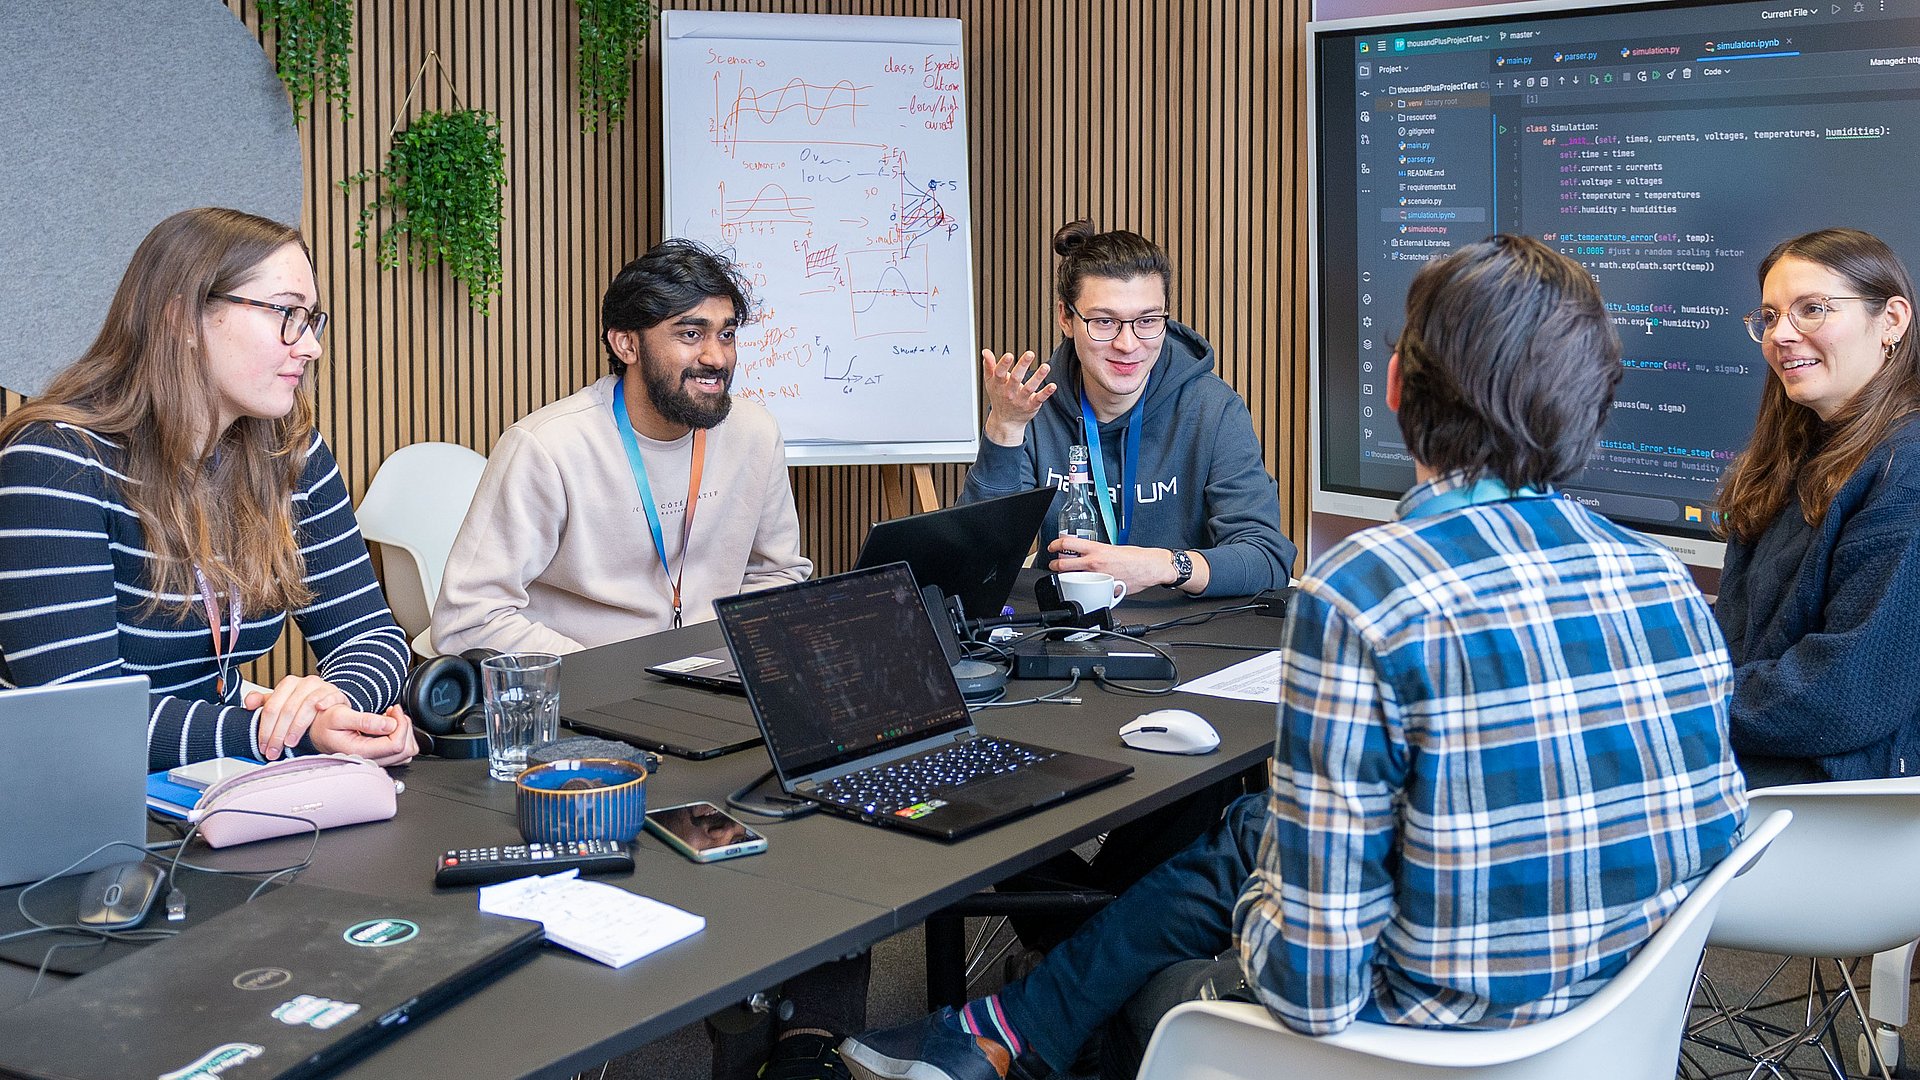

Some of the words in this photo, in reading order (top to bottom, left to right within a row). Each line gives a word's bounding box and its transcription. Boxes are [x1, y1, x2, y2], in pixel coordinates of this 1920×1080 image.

[1761, 11, 1792, 19] Current
[1793, 9, 1808, 17] File
[1509, 31, 1533, 39] master
[1407, 35, 1483, 48] thousandPlusProjectTest
[1716, 38, 1780, 50] simulation.ipynb
[1564, 52, 1597, 62] parser.py
[1632, 46, 1680, 57] simulation.py
[884, 56, 915, 74] class
[1506, 56, 1532, 66] main.py
[1870, 56, 1906, 67] Managed:
[1378, 63, 1402, 74] Project
[1704, 67, 1722, 76] Code
[1397, 82, 1478, 94] thousandPlusProjectTest
[1406, 113, 1437, 121] resources
[1406, 127, 1435, 138] .gitignore
[1526, 124, 1547, 133] class
[1550, 122, 1599, 132] Simulation:
[1543, 138, 1556, 146] def
[1625, 132, 1652, 143] times,
[1657, 131, 1699, 142] currents,
[1704, 129, 1748, 141] voltages,
[1753, 128, 1820, 139] temperatures,
[1825, 125, 1890, 138] humidities):
[1406, 142, 1430, 151] main.py
[1560, 150, 1599, 158] self.time
[1612, 148, 1635, 157] times
[1406, 156, 1436, 165] parser.py
[1560, 164, 1613, 172] self.current
[1625, 162, 1663, 172] currents
[1407, 169, 1445, 177] README.md
[1560, 178, 1613, 187] self.voltage
[1625, 176, 1663, 187] voltages
[1407, 184, 1456, 193] requirements.txt
[1560, 191, 1631, 200] self.temperature
[1644, 190, 1701, 200] temperatures
[1407, 198, 1442, 206] scenario.py
[1560, 205, 1617, 214] self.humidity
[1630, 204, 1677, 213] humidities
[1407, 211, 1456, 220] simulation.ipynb
[1407, 225, 1448, 235] simulation.py
[1400, 239, 1423, 247] External
[1424, 239, 1450, 247] Libraries
[1543, 232, 1557, 240] def
[1560, 233, 1681, 243] get_temperature_error(self,
[1685, 233, 1715, 244] temp):
[1400, 252, 1429, 261] Scratches
[1577, 247, 1604, 255] 0.0005
[1608, 246, 1631, 256] #just
[1645, 247, 1673, 256] random
[1676, 247, 1710, 259] scaling
[1715, 248, 1745, 257] factor
[1599, 261, 1715, 272] math.exp(math.sqrt(temp))
[931, 286, 939, 297] A
[1605, 303, 1676, 314] dity_logic(self,
[1681, 305, 1729, 316] humidity):
[1621, 358, 1690, 371] set_error(self,
[1714, 364, 1749, 375] sigma):
[1658, 402, 1686, 413] sigma)
[1599, 440, 1738, 460] tistical_Error_time_step(self,
[1609, 454, 1659, 467] temperature
[1663, 460, 1678, 468] and
[1681, 461, 1720, 474] humidity
[1576, 496, 1600, 507] Search
[431, 682, 451, 707] R
